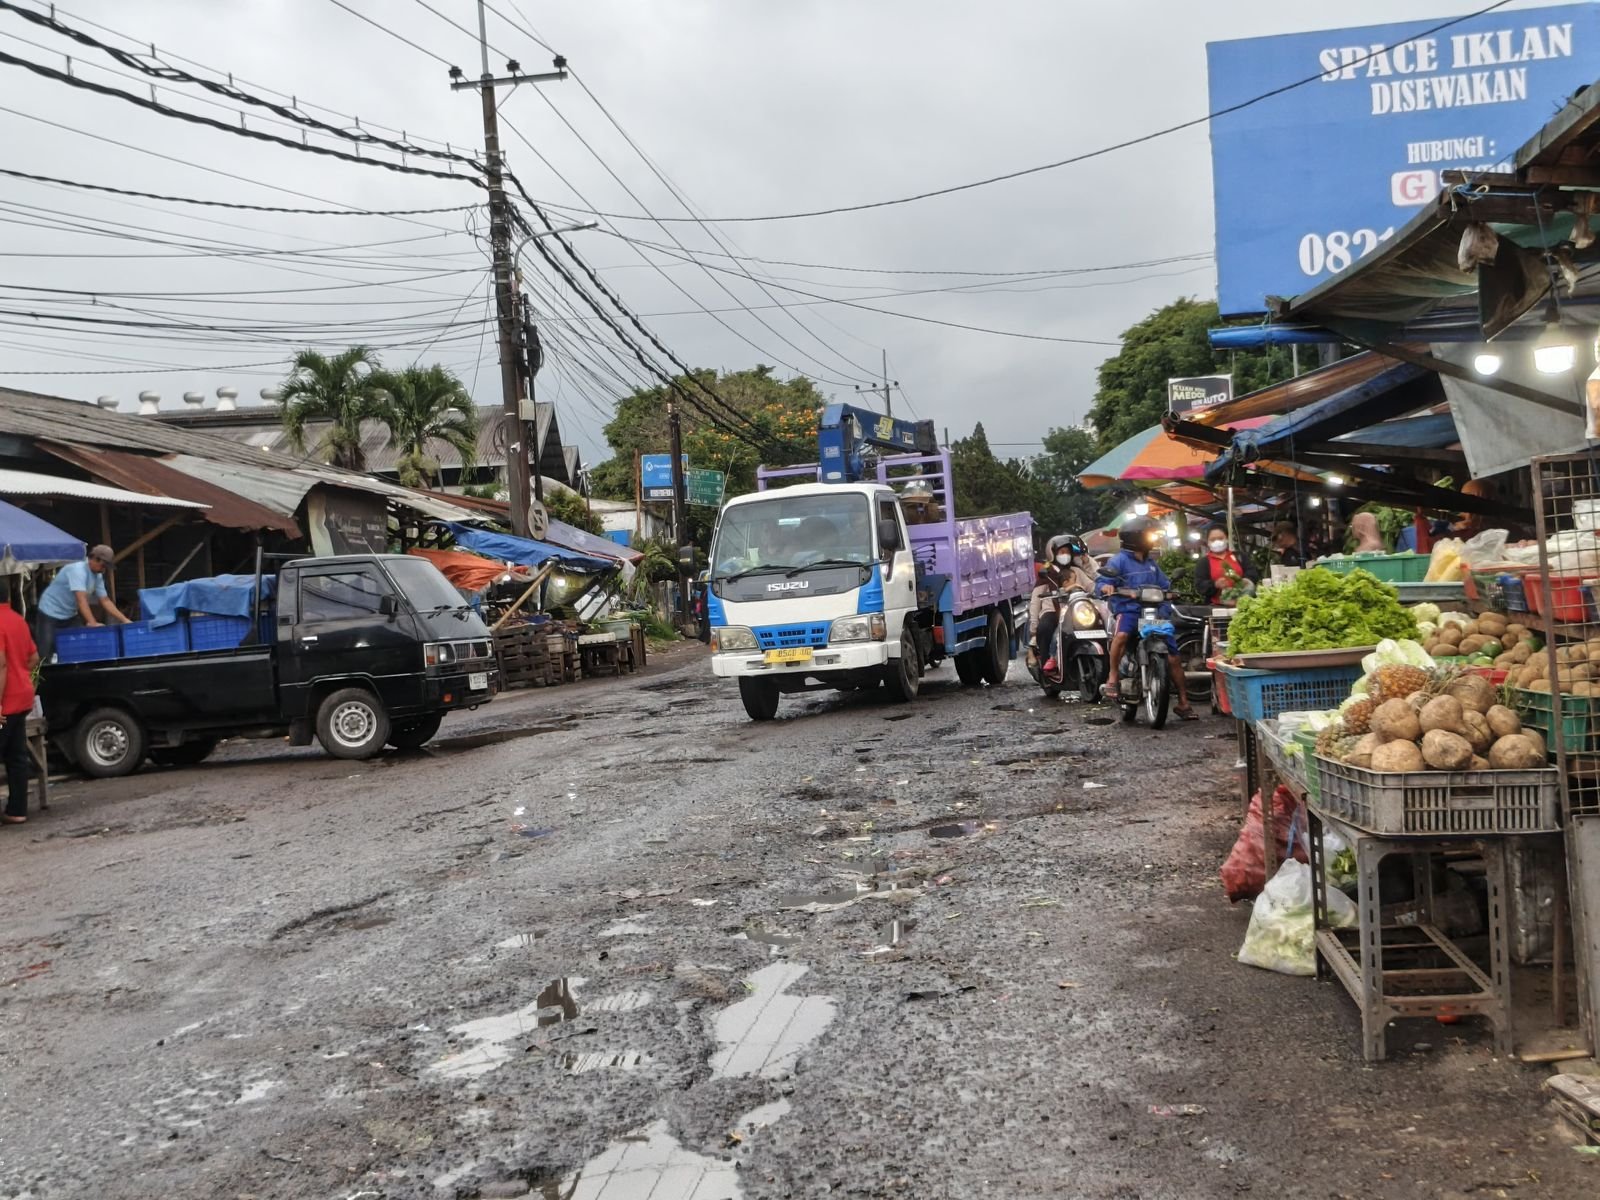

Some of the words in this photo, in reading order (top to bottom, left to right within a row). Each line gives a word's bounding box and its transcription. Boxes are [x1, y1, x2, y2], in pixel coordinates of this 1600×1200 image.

[1319, 39, 1438, 82] SPACE
[1451, 23, 1573, 69] IKLAN
[1370, 67, 1527, 115] DISEWAKAN
[1407, 136, 1484, 164] HUBUNGI
[1399, 174, 1427, 201] G
[1203, 392, 1227, 405] AUTO
[767, 581, 808, 591] ISUZU
